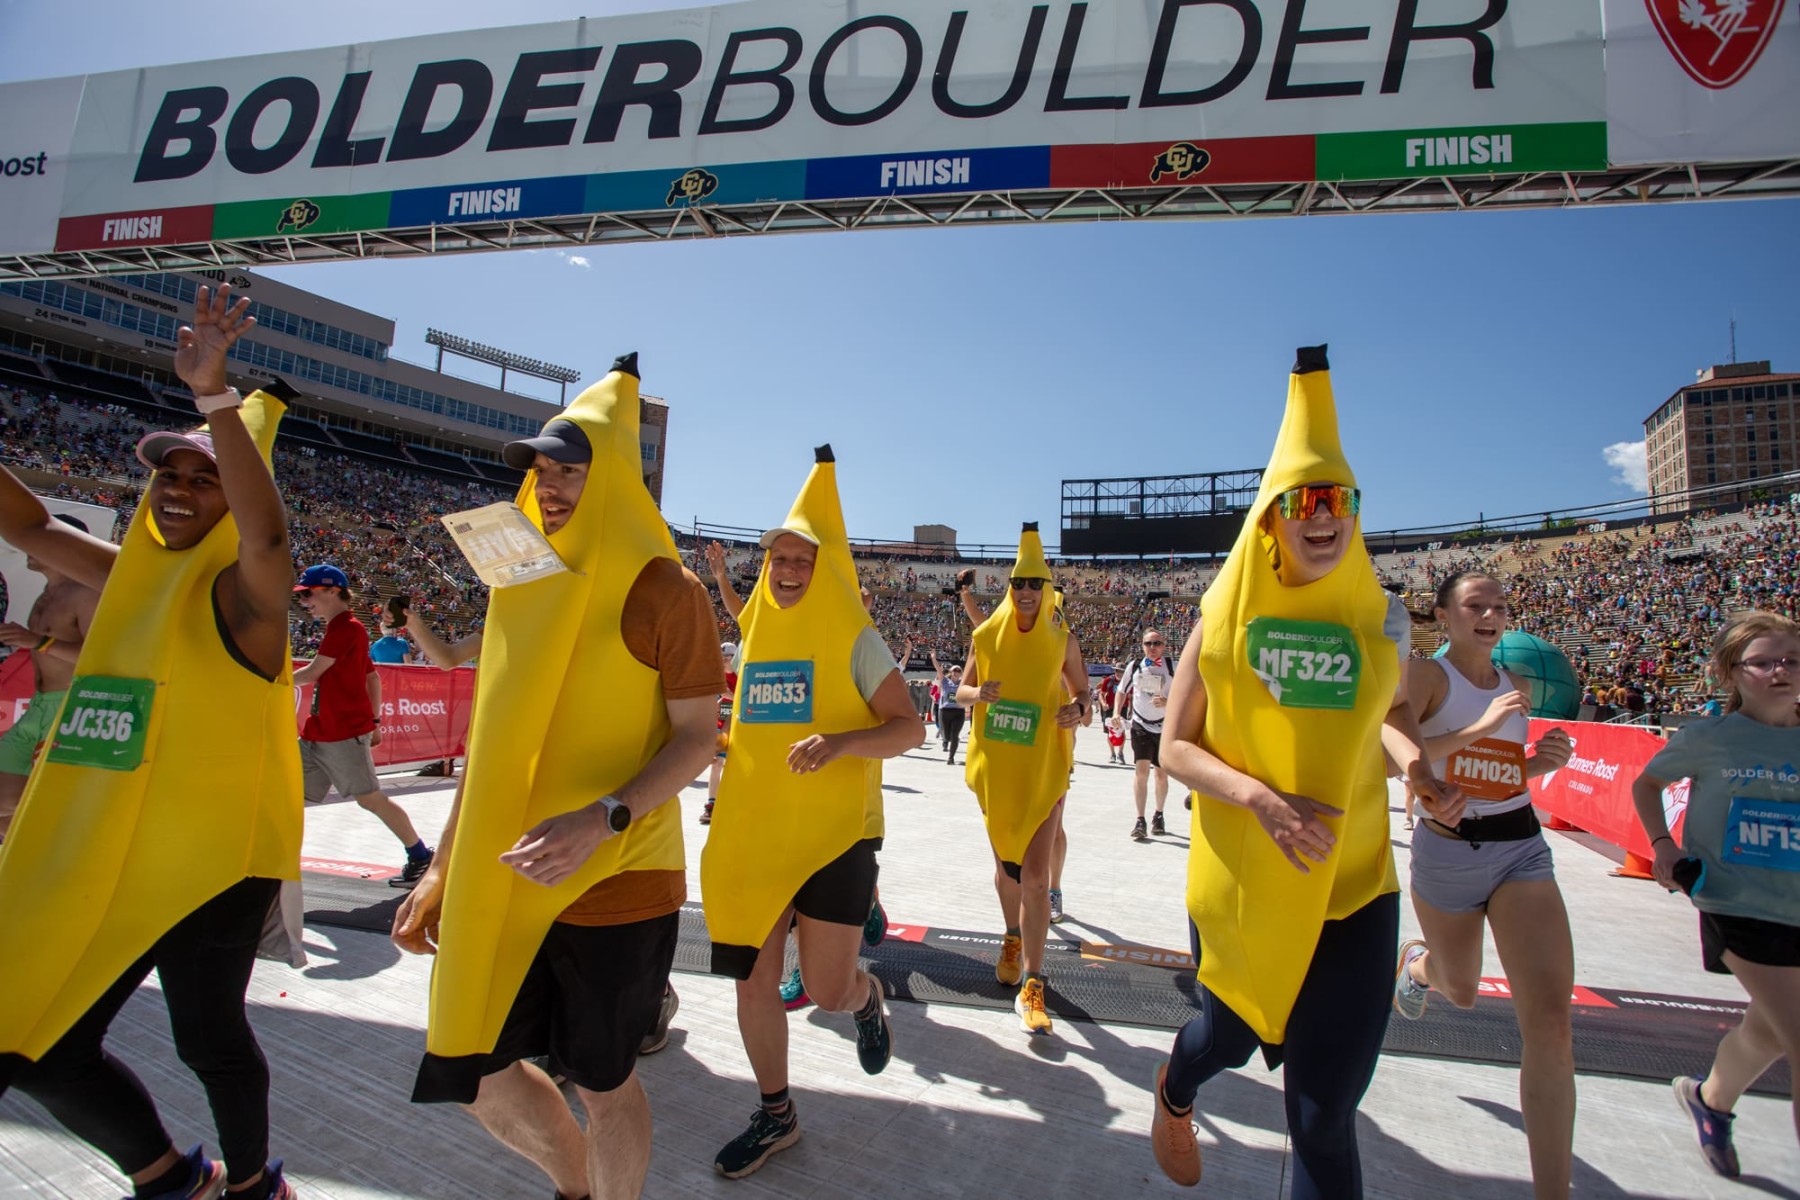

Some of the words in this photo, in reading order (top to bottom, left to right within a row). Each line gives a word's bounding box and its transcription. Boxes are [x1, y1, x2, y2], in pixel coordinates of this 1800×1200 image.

[133, 0, 1508, 183] BOLDERBOULDER
[0, 152, 47, 176] ost
[1406, 134, 1512, 168] FINISH
[880, 158, 970, 188] FINISH
[448, 187, 521, 216] FINISH
[102, 216, 163, 241] FINISH
[89, 279, 129, 299] NATIONAL
[131, 292, 178, 314] CHAMPIONS
[1588, 522, 1606, 533] 206
[1427, 541, 1443, 550] 207
[1267, 630, 1343, 645] BOLDERBOULDER
[1259, 647, 1352, 683] MF322
[398, 698, 447, 716] Roost
[748, 683, 806, 705] MB633
[60, 706, 134, 742] JC336
[993, 713, 1032, 732] MF161
[1454, 755, 1522, 786] MM029
[1565, 752, 1596, 775] Runners
[1592, 758, 1619, 781] Roost
[1721, 768, 1774, 780] BOLDER
